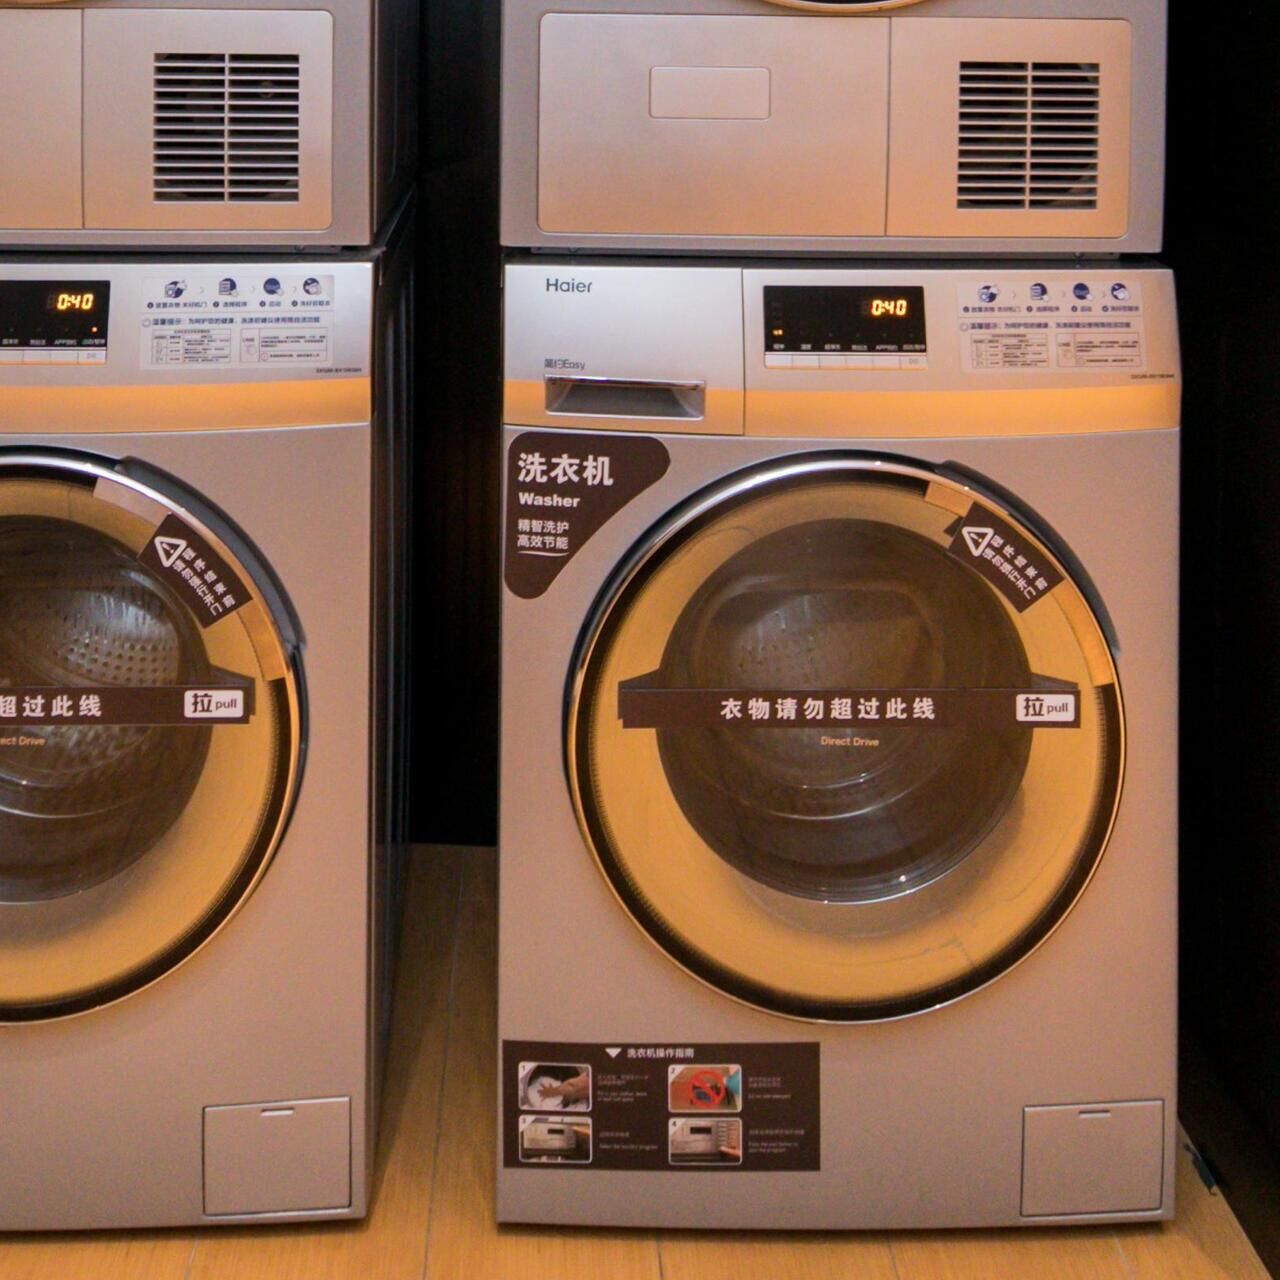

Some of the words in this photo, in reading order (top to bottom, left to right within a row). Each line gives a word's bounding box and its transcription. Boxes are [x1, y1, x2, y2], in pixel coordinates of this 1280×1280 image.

[546, 278, 593, 294] Haier
[57, 293, 94, 310] 0:40
[872, 299, 907, 316] 0:40
[518, 452, 614, 486] 洗衣机
[518, 492, 581, 508] Washer
[518, 519, 570, 534] 精智洗护
[517, 534, 569, 550] 高效节能
[190, 693, 212, 714] 拉
[215, 698, 238, 712] pull
[720, 696, 936, 720] 衣物请勿超过此线
[1023, 696, 1044, 716] 拉
[1046, 701, 1070, 716] pull
[18, 735, 46, 747] Drive
[820, 735, 851, 746] Direct
[853, 736, 880, 748] Drive
